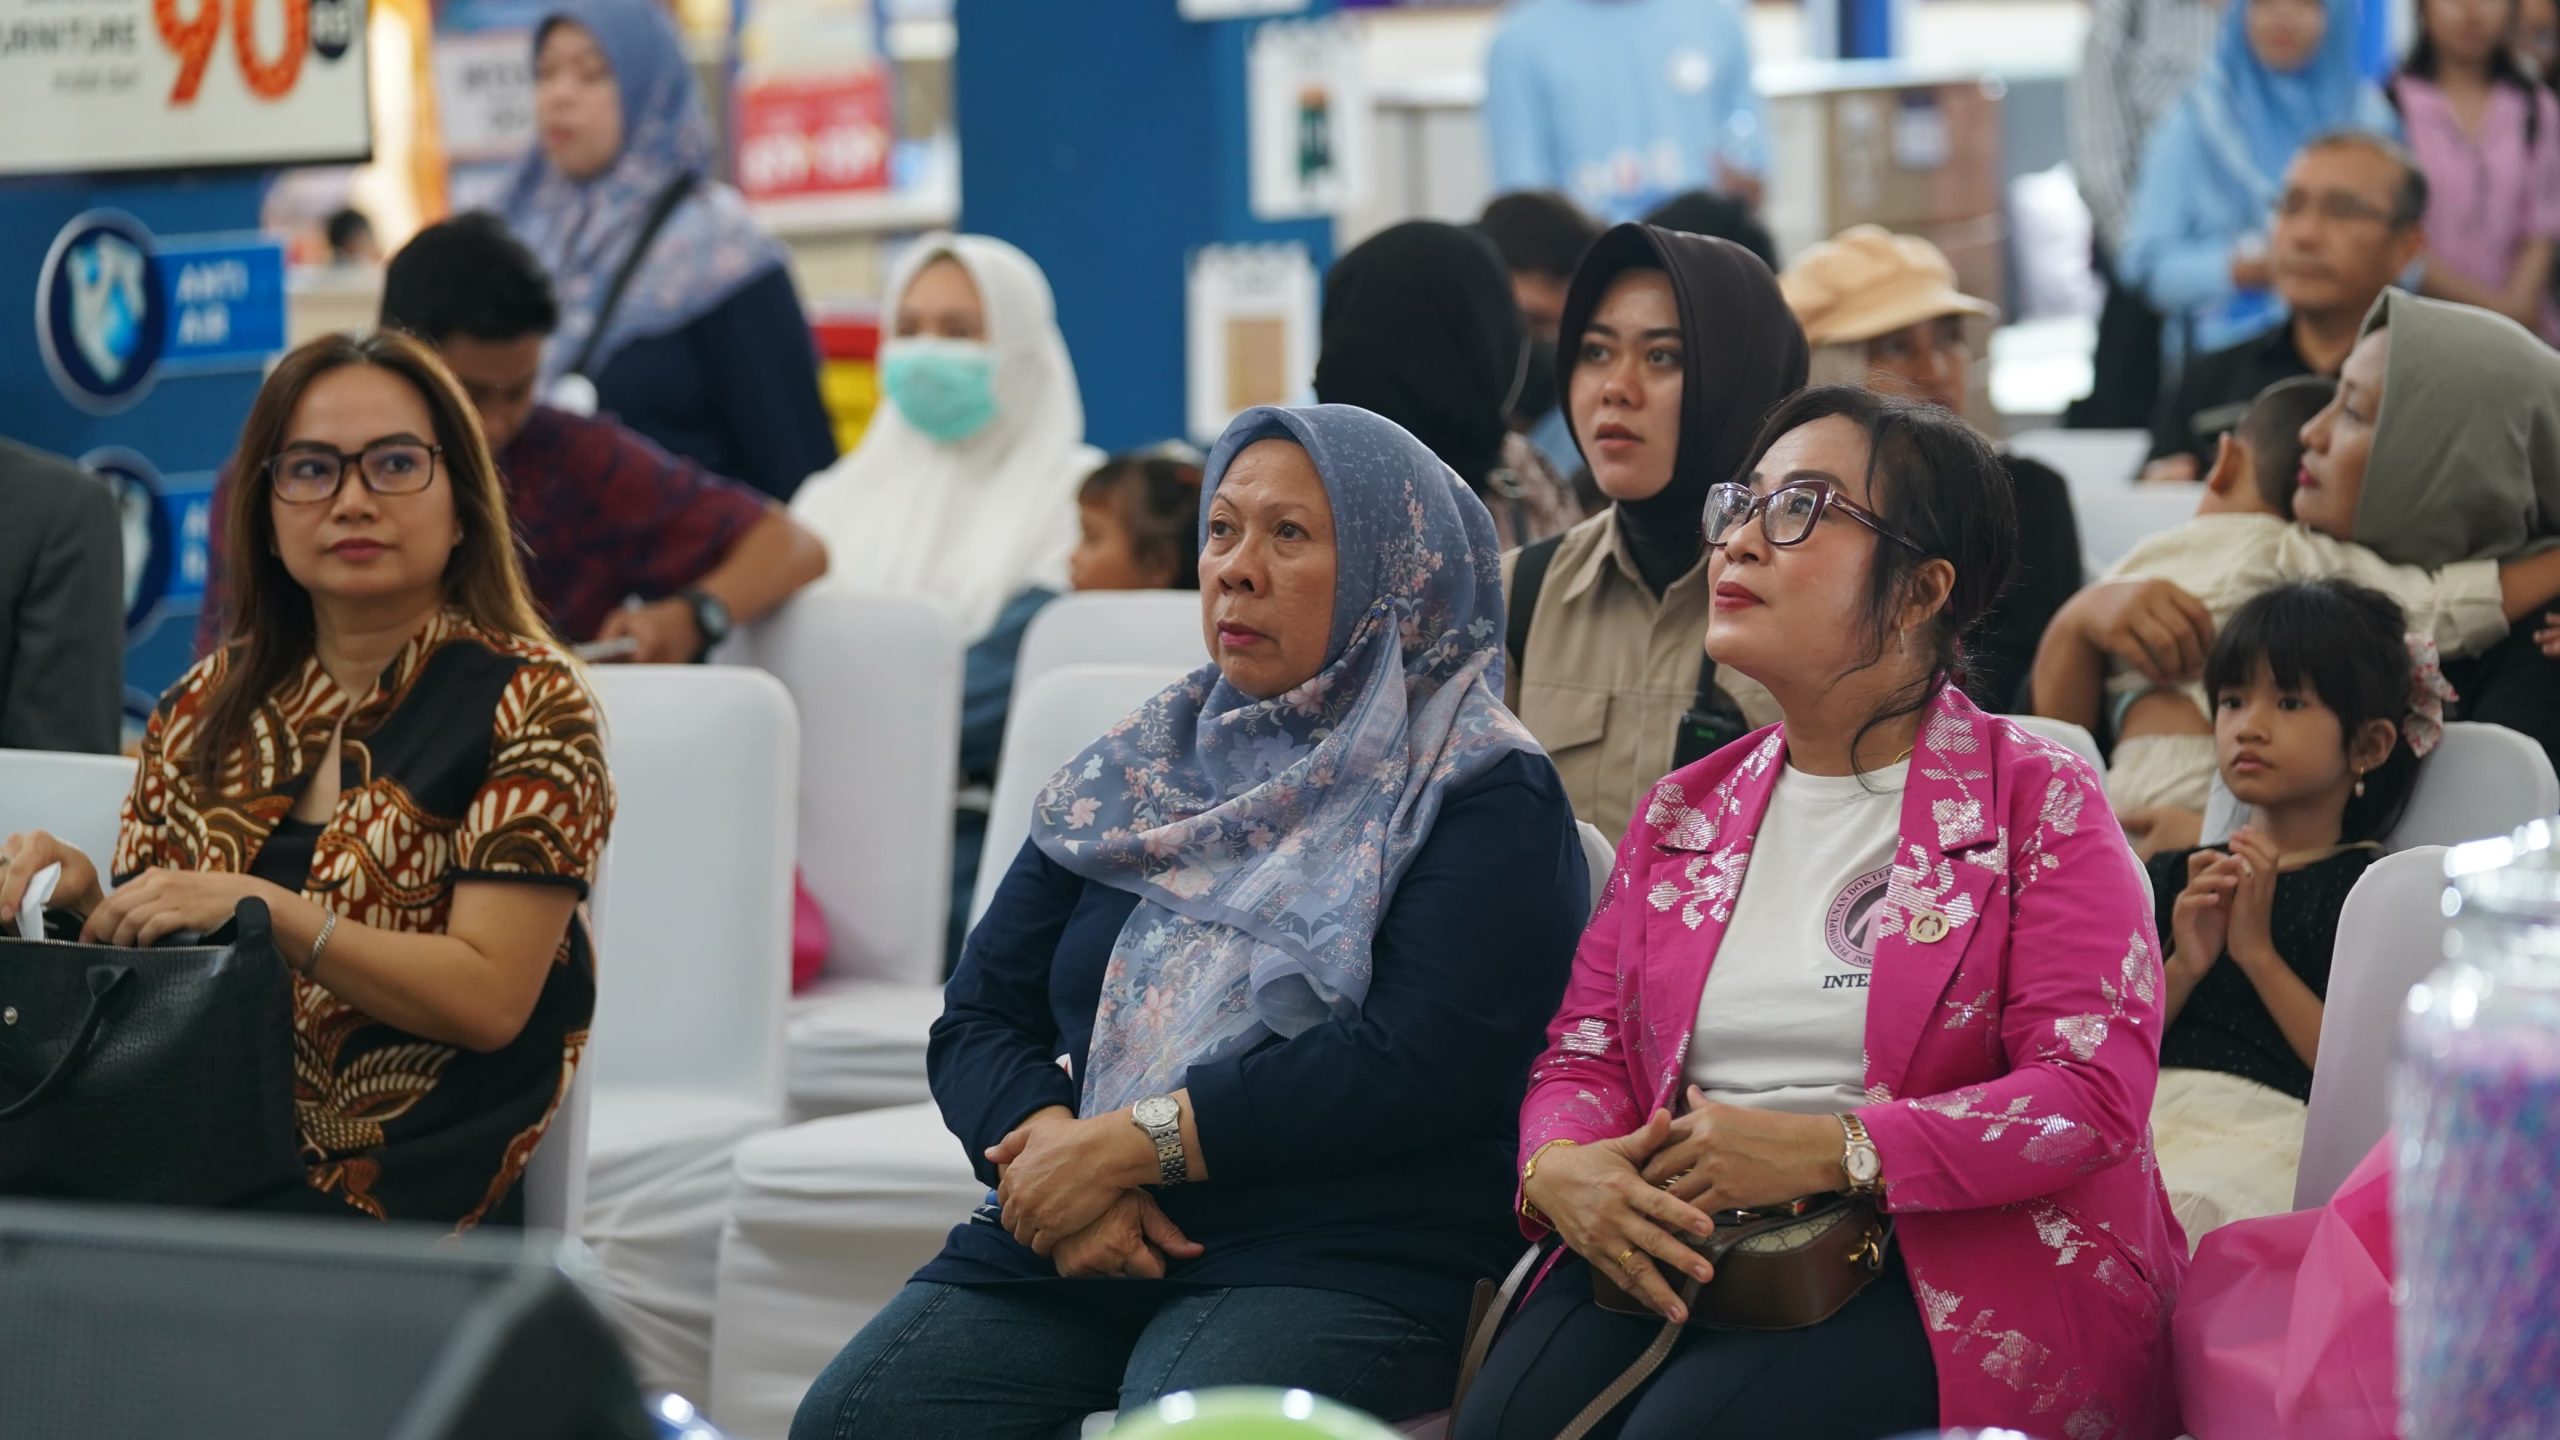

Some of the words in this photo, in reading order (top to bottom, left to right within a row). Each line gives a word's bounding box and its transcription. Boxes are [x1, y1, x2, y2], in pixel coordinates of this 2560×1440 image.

[152, 0, 310, 107] 90
[177, 260, 248, 303] ANTI
[1822, 973, 1872, 989] INTE
